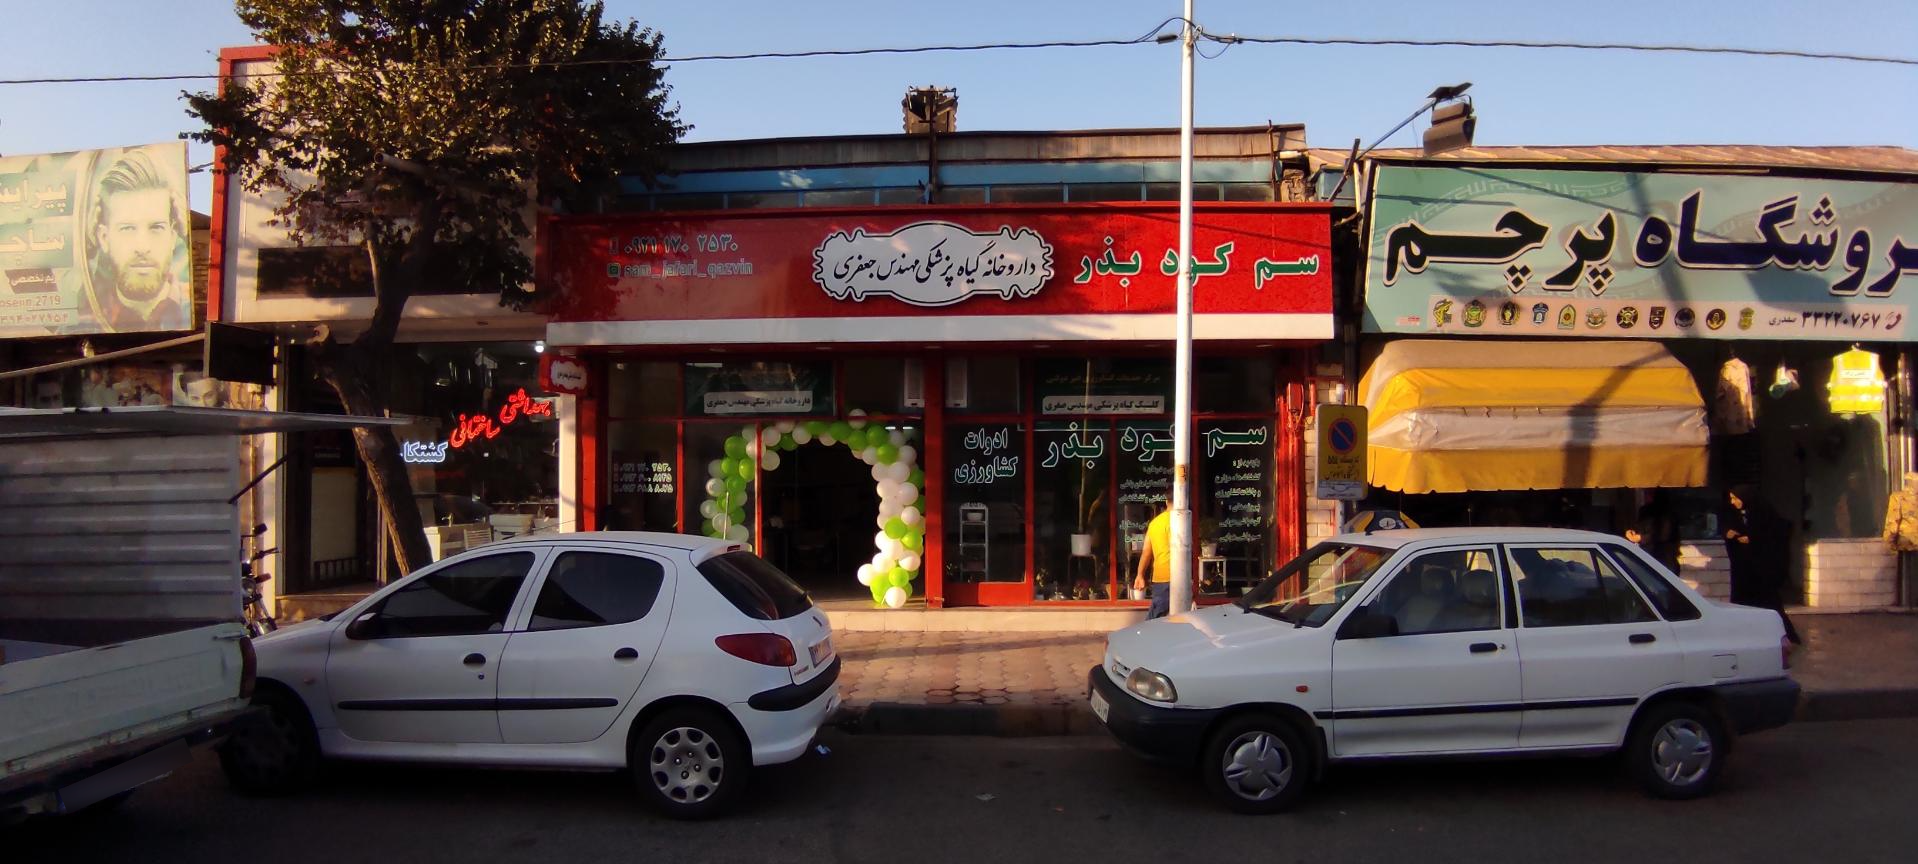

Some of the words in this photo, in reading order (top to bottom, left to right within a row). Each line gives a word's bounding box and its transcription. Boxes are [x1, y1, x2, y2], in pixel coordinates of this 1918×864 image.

[1383, 206, 1619, 295] پرچم
[1635, 188, 1918, 296] روشگاه
[833, 252, 876, 283] جعفری
[877, 252, 919, 281] مهندس
[915, 238, 953, 287] پزشکی
[957, 240, 996, 284] گیاه
[982, 252, 1036, 277] داروخانه
[1073, 235, 1142, 288] بذر
[1254, 253, 1320, 289] سم
[1802, 311, 1881, 328] ۳۳۲۲۰۷۶۷
[499, 387, 552, 424] بهداشتی
[450, 413, 501, 448] ساختمانی
[964, 426, 1009, 455] ادوات
[1041, 421, 1104, 469] بذر
[1207, 425, 1267, 458] سم
[403, 440, 449, 463] کشتکا
[954, 455, 1018, 484] کشاورزی
